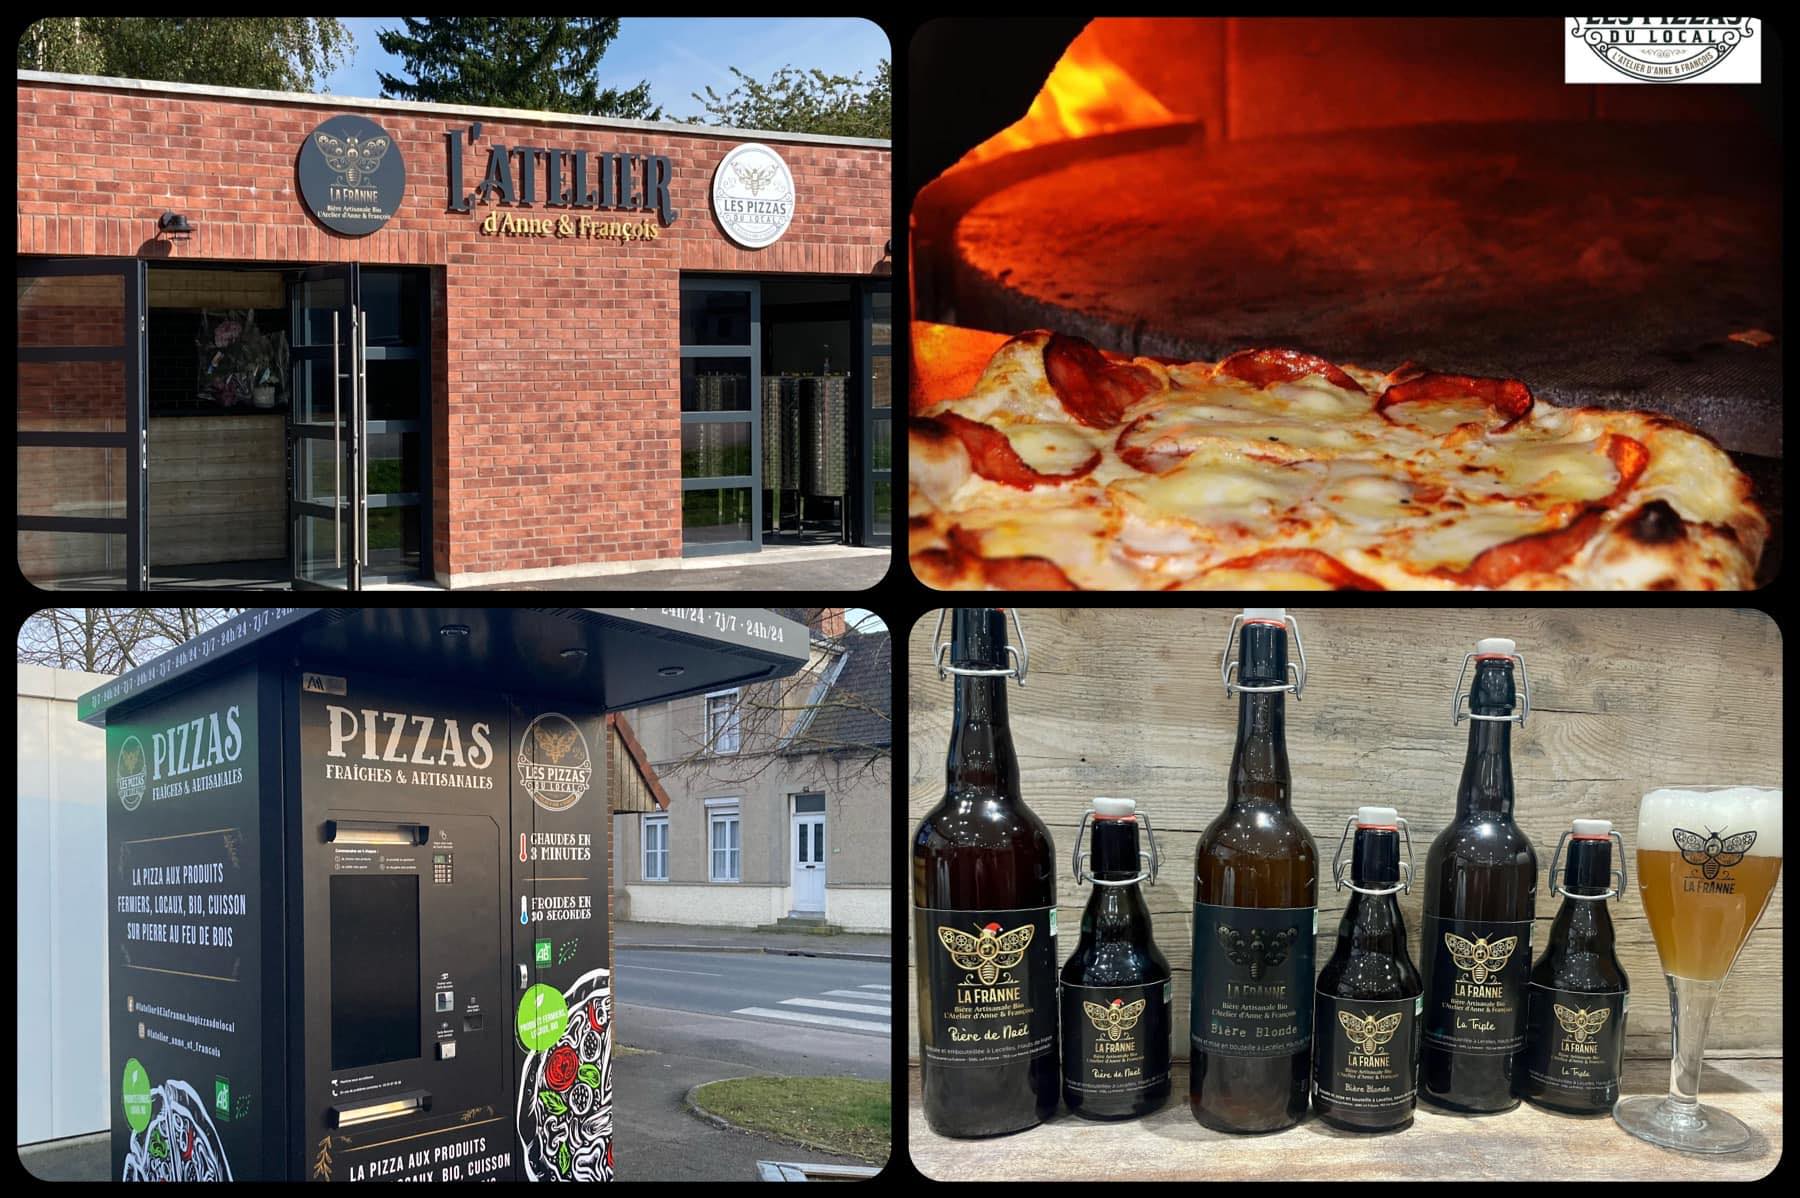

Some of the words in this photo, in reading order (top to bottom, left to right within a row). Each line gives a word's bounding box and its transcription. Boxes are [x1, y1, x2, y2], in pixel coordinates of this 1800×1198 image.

[446, 122, 678, 226] L'ATELIER
[330, 187, 340, 201] LA
[724, 199, 744, 213] LES
[747, 201, 786, 215] PIZZAS
[484, 212, 553, 234] d'Anne
[559, 214, 575, 235] &
[581, 215, 659, 241] François
[714, 611, 736, 632] 7j/7
[746, 619, 784, 642] 24h/24
[152, 704, 242, 781] PIZZAS
[326, 705, 493, 770] PIZZAS
[184, 782, 191, 795] &
[192, 767, 243, 793] ARTISANALES
[396, 769, 407, 784] &
[412, 771, 493, 789] ARTISANALES
[526, 766, 544, 780] LES
[548, 768, 585, 783] PIZZAS
[531, 833, 576, 845] CHAUDES
[579, 834, 591, 846] EN
[541, 847, 591, 861] MINUTES
[132, 868, 141, 886] LA
[143, 867, 163, 885] PIZZA
[166, 866, 181, 885] AUX
[183, 863, 224, 884] PRODUITS
[1684, 880, 1695, 892] LA
[1697, 881, 1736, 895] FRANNE
[117, 895, 153, 916] FERMIERS,
[154, 895, 186, 917] LOCAUX,
[188, 895, 206, 917] BIO,
[208, 894, 246, 915] CUISSON
[531, 896, 576, 910] FROIDES
[579, 895, 592, 908] EN
[546, 909, 592, 921] SECONDES
[127, 922, 140, 941] SUR
[142, 922, 167, 943] PIERRE
[169, 924, 179, 944] AU
[182, 925, 196, 945] FEU
[199, 925, 209, 946] DE
[212, 926, 233, 947] BOIS
[957, 988, 972, 1004] LA
[974, 987, 1021, 1004] FRANNE
[1455, 983, 1466, 996] LA
[1467, 985, 1503, 998] FRANNE
[944, 1012, 972, 1020] L'Atelier
[974, 1004, 1011, 1013] Artisanale
[1211, 1023, 1247, 1038] Bière
[1256, 1024, 1297, 1038] Blonde
[1456, 1016, 1467, 1029] La
[1468, 1018, 1496, 1032] Triple
[948, 1026, 981, 1042] Bière
[984, 1029, 1000, 1041] de
[1095, 1043, 1104, 1053] LA
[1105, 1041, 1136, 1053] FRANNE
[1561, 1042, 1570, 1052] LA
[1571, 1043, 1598, 1054] FRANNE
[1348, 1055, 1357, 1066] LA
[1359, 1055, 1390, 1067] FRANNE
[1114, 1070, 1123, 1078] de
[1561, 1066, 1570, 1075] La
[1345, 1082, 1365, 1093] Bière
[350, 1164, 365, 1182] LA
[370, 1155, 404, 1178] PIZZA
[408, 1149, 430, 1169] AUX
[434, 1137, 486, 1162] PRODUITS
[442, 1165, 464, 1182] BIO,
[468, 1152, 511, 1176] CUISSON
